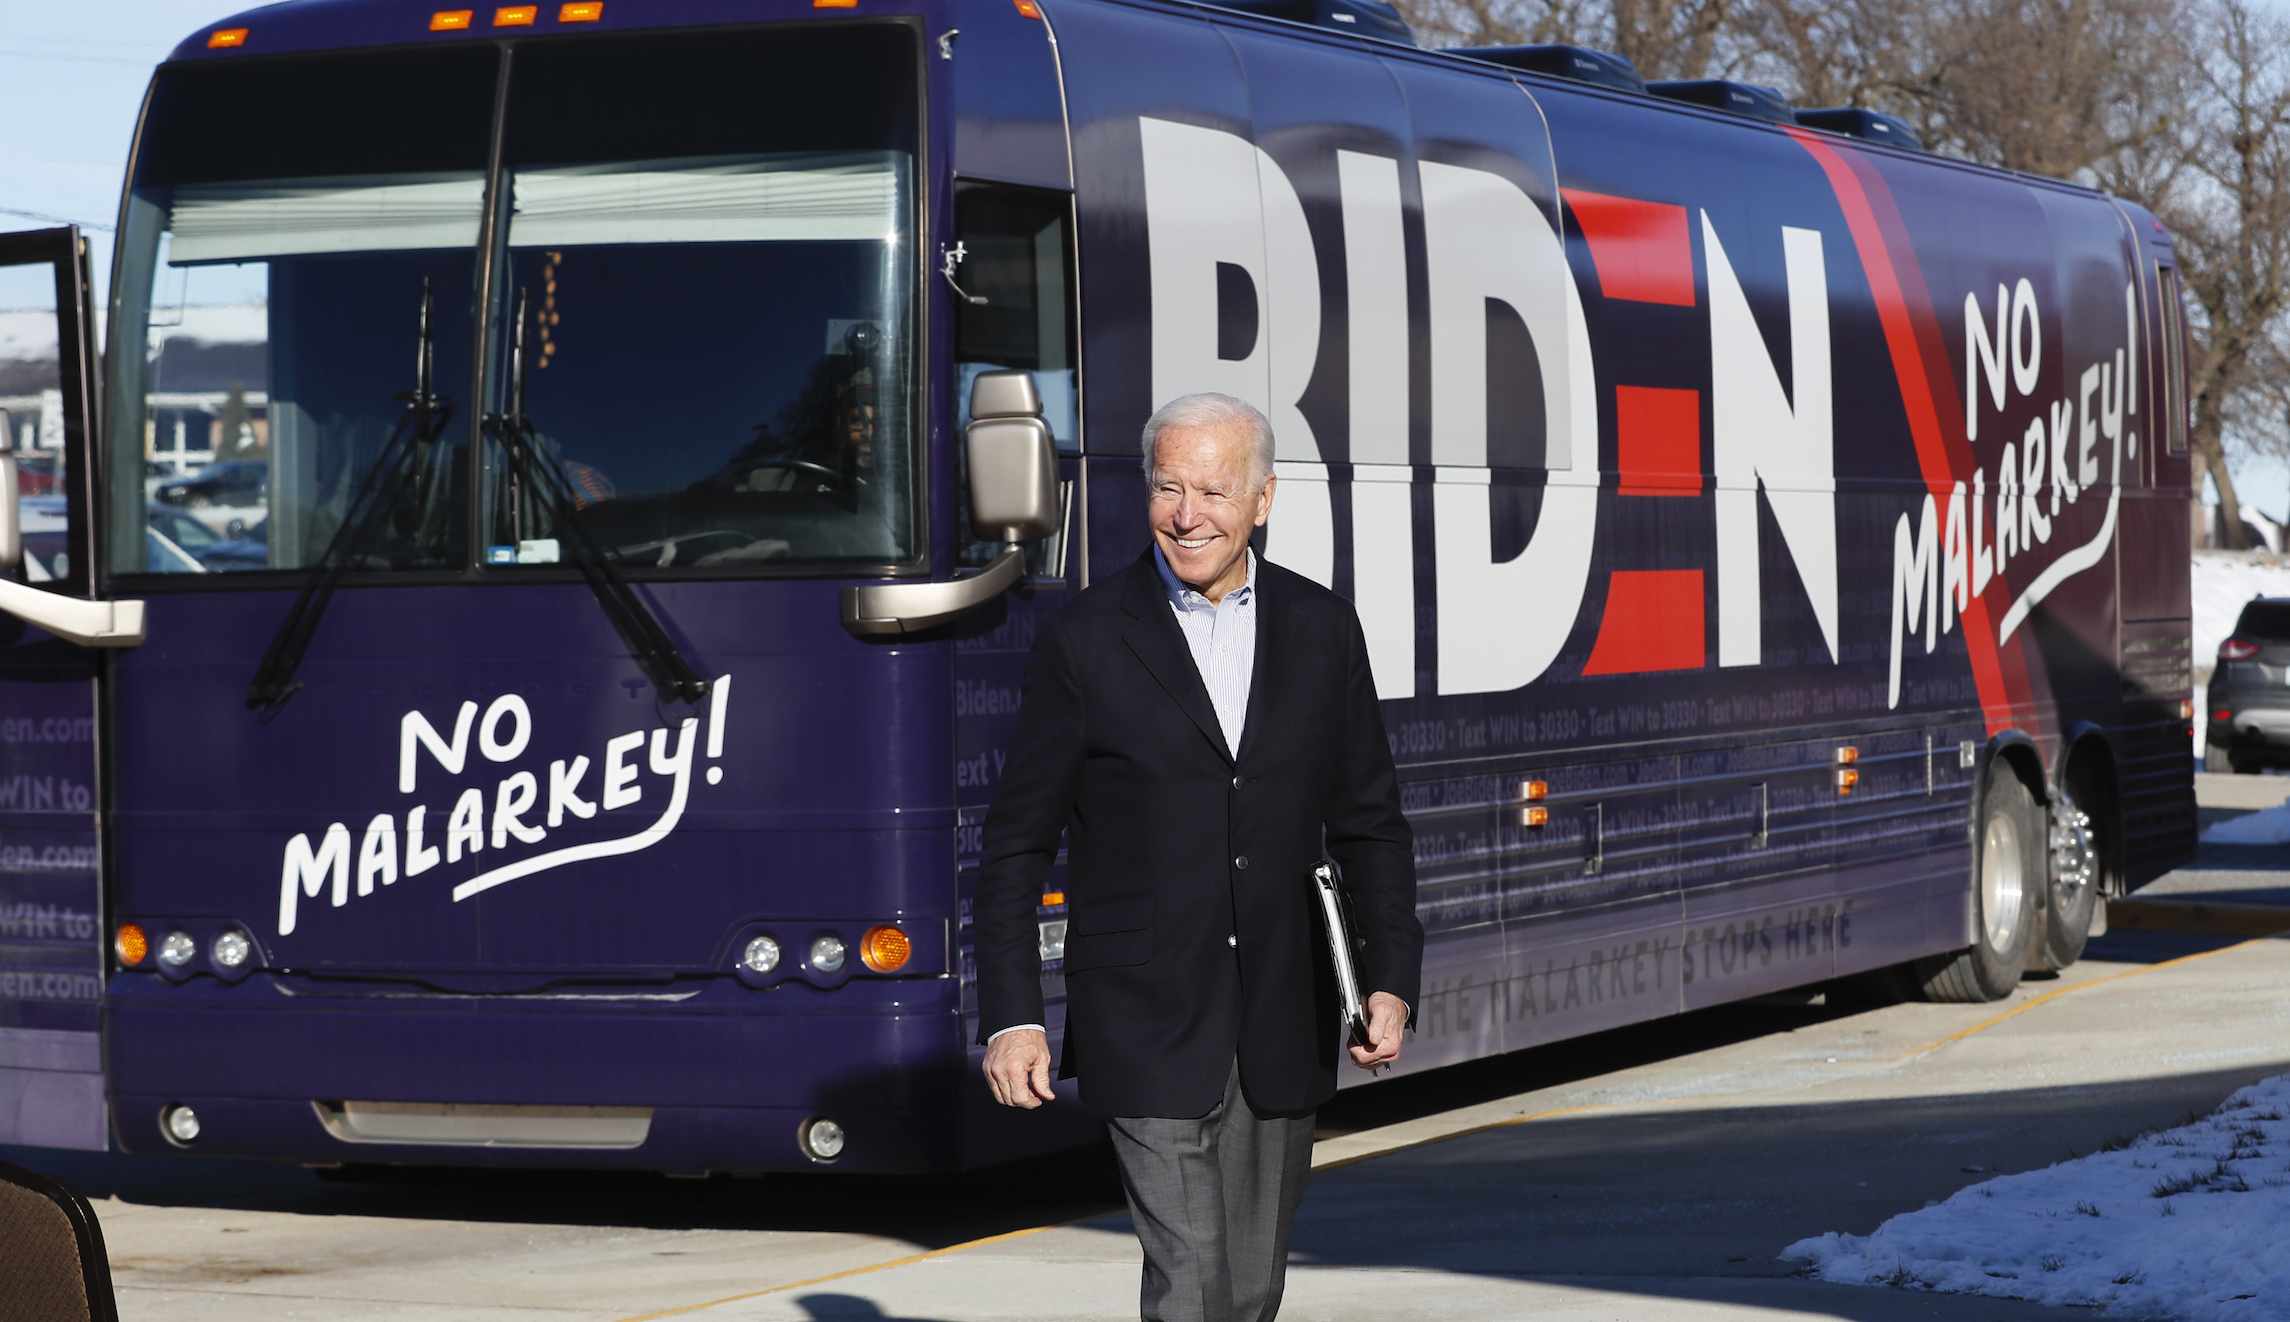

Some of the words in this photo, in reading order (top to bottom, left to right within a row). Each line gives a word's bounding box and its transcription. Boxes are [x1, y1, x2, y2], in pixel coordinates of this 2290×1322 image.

[1139, 115, 1840, 700] BIDEN
[1964, 277, 2042, 442] NO
[1888, 280, 2138, 710] MALARKEY!
[60, 779, 91, 810] to
[400, 693, 532, 793] NO
[1400, 719, 1446, 755] 30330
[1456, 717, 1487, 748] Text
[1489, 714, 1520, 746] WIN
[1522, 718, 1537, 742] to
[1538, 708, 1579, 742] 30330
[1589, 707, 1616, 736] Text
[1617, 703, 1645, 732] WIN
[1647, 706, 1660, 731] to
[1661, 699, 1698, 730] 30330
[1707, 698, 1731, 725] Text
[1732, 695, 1758, 722] WIN
[278, 674, 731, 936] MALARKEY!
[1407, 974, 1473, 1043] HE
[1490, 935, 1670, 1026] MALARKEY
[1681, 914, 1773, 987] STOPS
[1785, 898, 1853, 961] HERE
